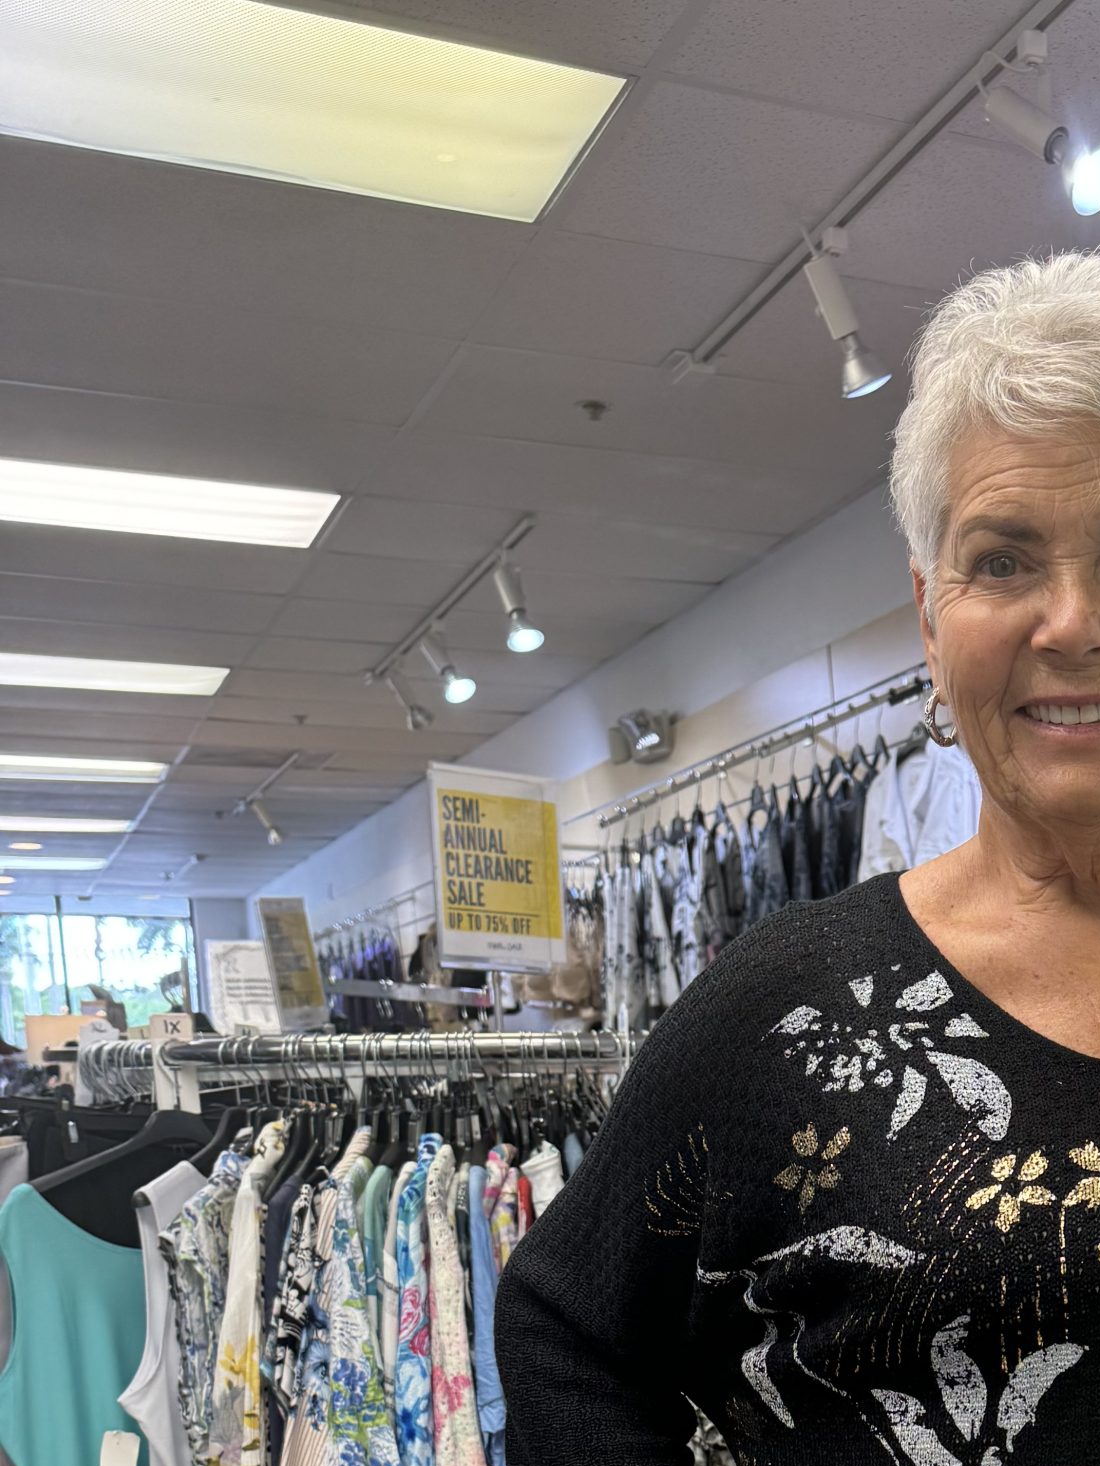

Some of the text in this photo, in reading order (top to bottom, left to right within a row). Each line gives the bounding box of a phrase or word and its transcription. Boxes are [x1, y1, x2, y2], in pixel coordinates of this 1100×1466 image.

[442, 795, 486, 824] SEMI-
[443, 824, 508, 855] ANNUAL
[445, 852, 534, 885] CLEARANCE
[447, 879, 486, 908] SALE
[448, 912, 532, 935] UP TO 75% OFF
